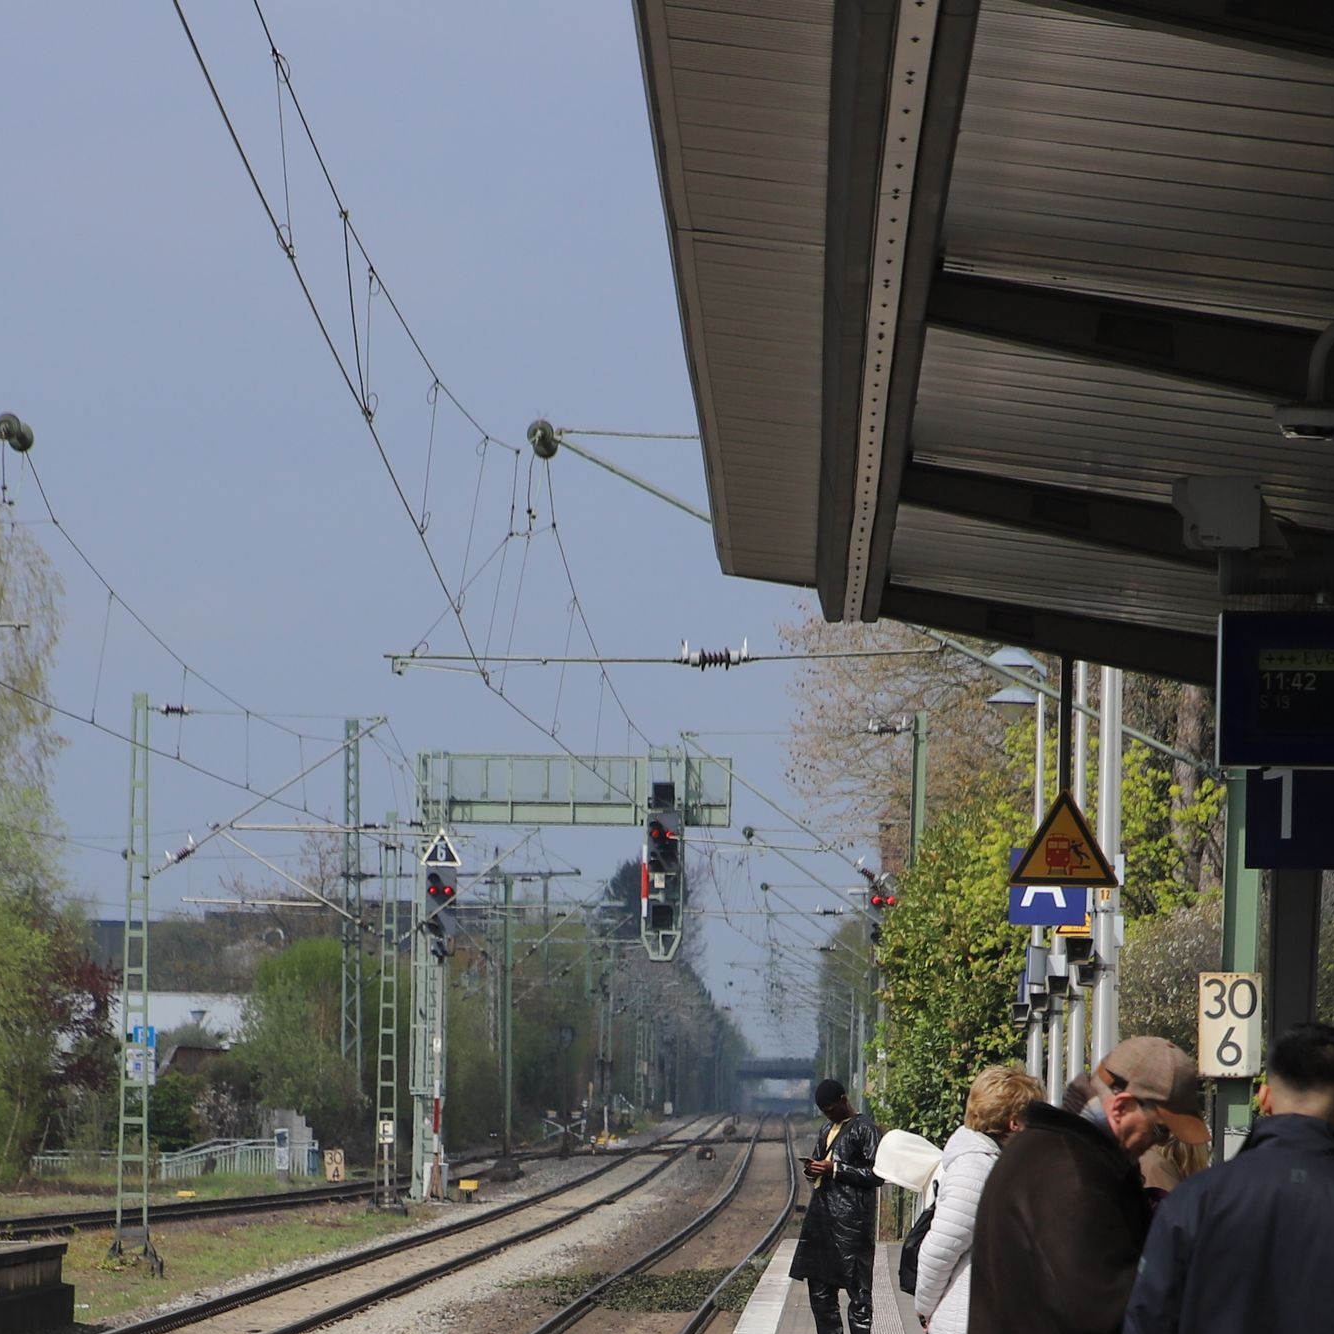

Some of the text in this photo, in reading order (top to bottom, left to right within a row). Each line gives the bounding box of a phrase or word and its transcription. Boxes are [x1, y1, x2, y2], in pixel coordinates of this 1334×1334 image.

[1261, 672, 1317, 691] 11:42
[436, 843, 447, 861] 6
[1100, 889, 1111, 900] 12
[1204, 978, 1258, 1020] 30
[1216, 1026, 1243, 1067] 6
[327, 1152, 343, 1166] 30
[332, 1167, 340, 1180] 4
